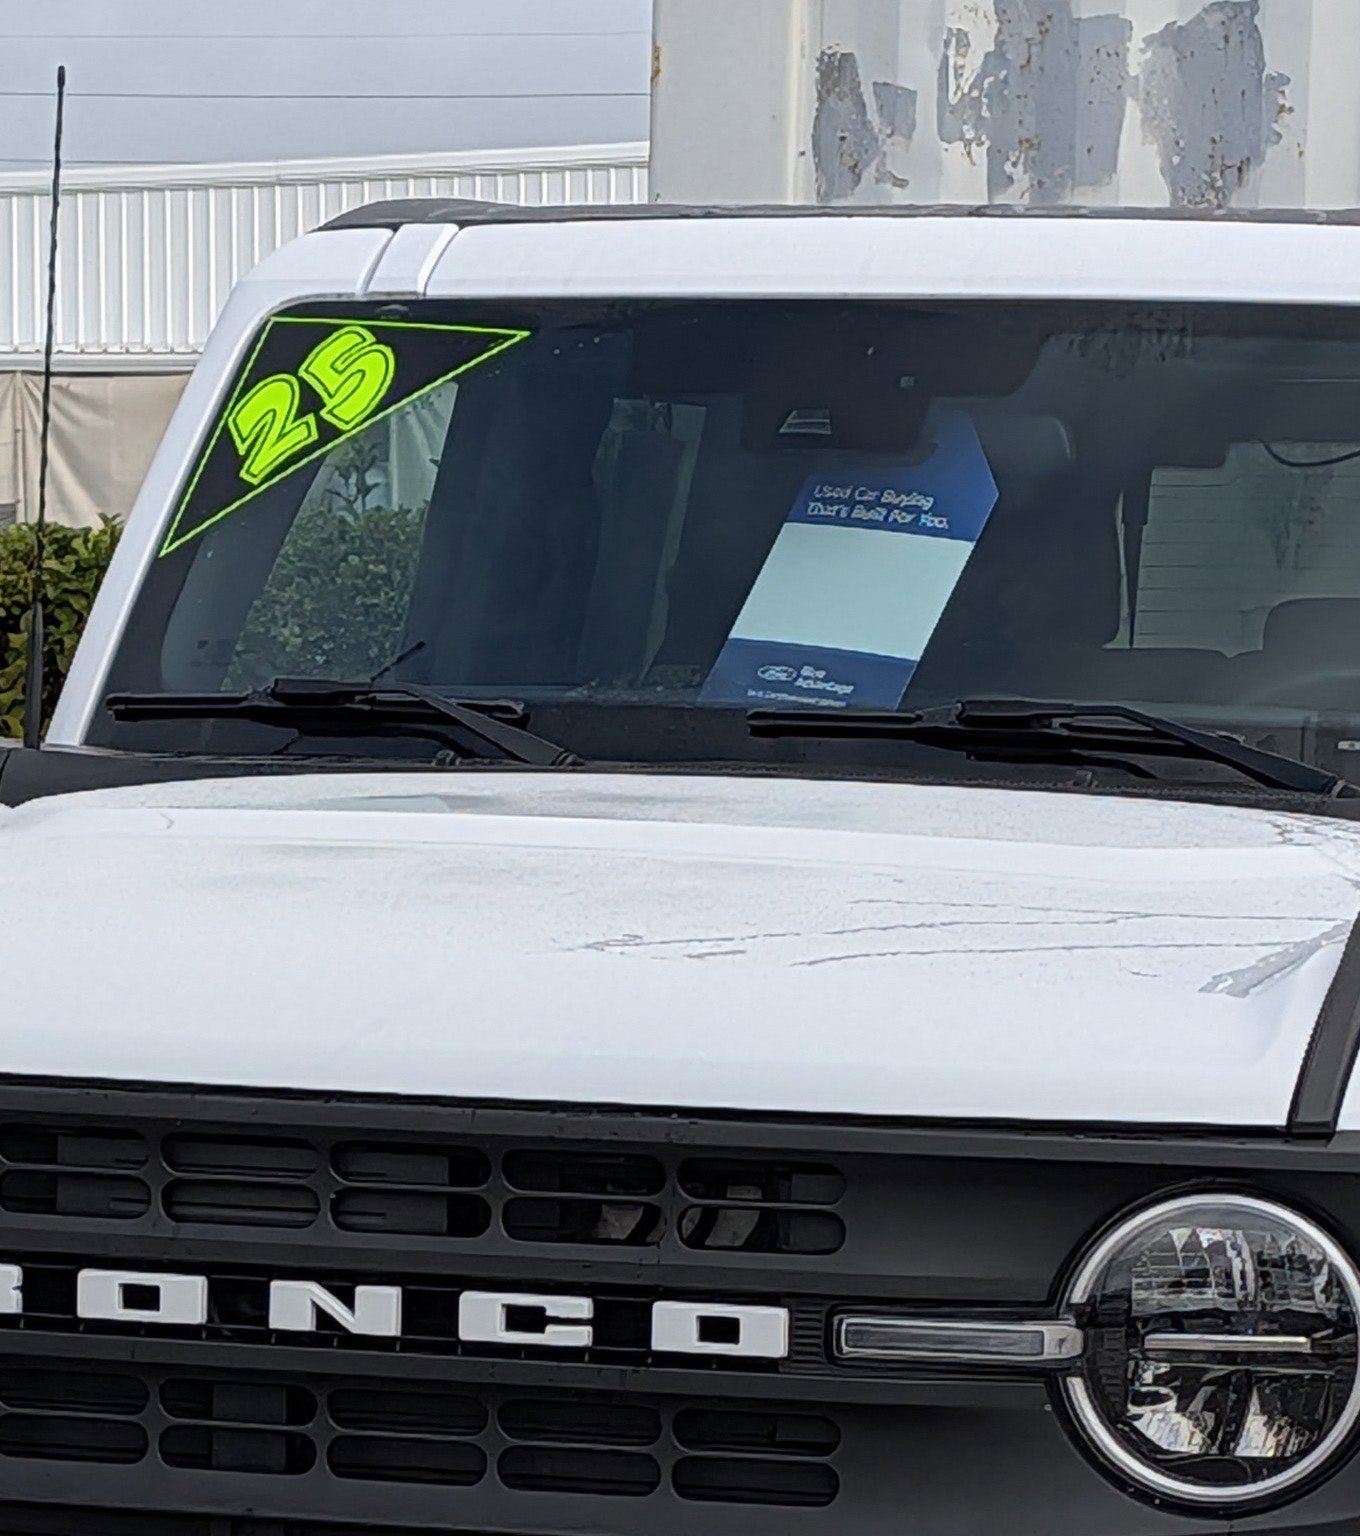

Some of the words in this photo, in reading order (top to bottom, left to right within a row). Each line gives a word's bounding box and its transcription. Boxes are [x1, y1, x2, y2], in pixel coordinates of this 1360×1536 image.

[228, 325, 396, 486] 25
[813, 485, 853, 499] Used
[855, 487, 880, 500] Car
[881, 489, 934, 511] Buying
[807, 502, 851, 518] That's
[851, 505, 888, 521] Built
[889, 509, 917, 524] For
